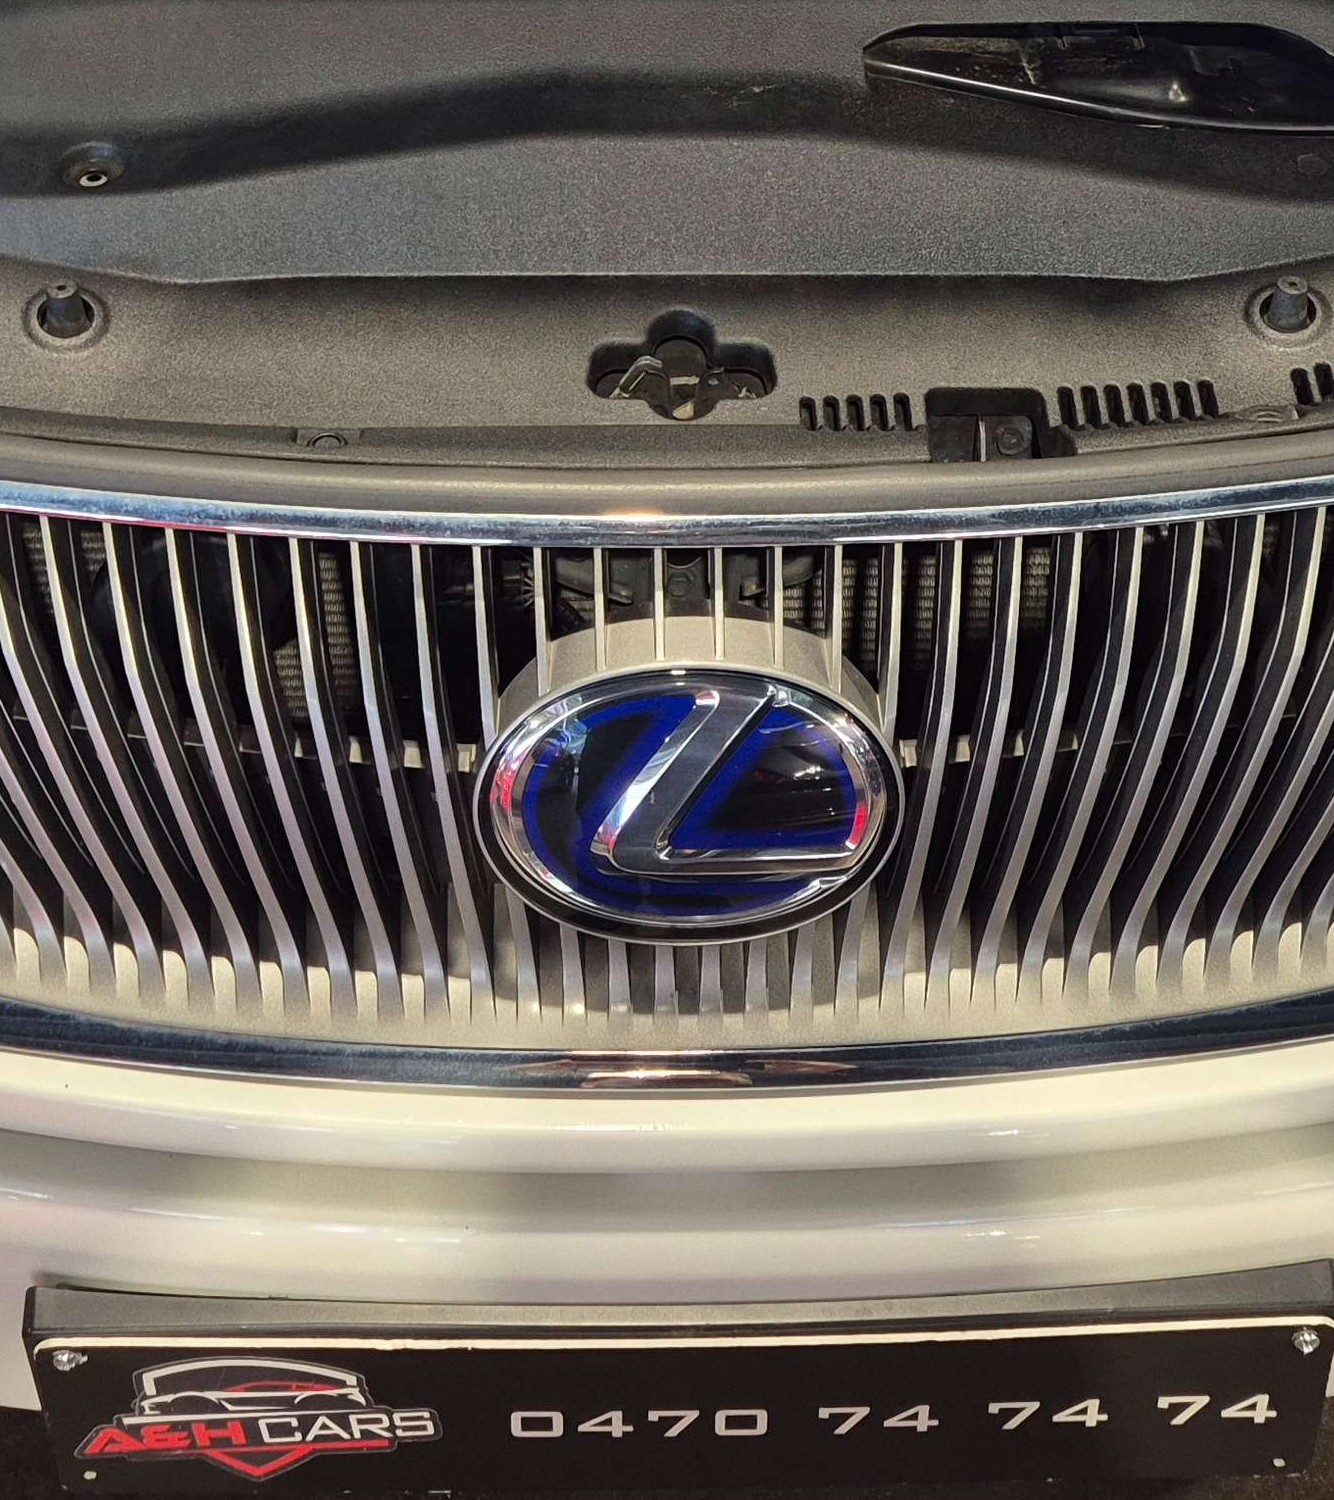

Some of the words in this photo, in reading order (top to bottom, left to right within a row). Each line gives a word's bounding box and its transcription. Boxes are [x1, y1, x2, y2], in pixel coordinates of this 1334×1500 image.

[83, 1420, 247, 1456] A&H
[258, 1410, 436, 1444] CARS
[509, 1408, 769, 1439] 0470
[817, 1403, 941, 1435] 74
[987, 1397, 1110, 1431] 74
[1156, 1392, 1278, 1426] 74
